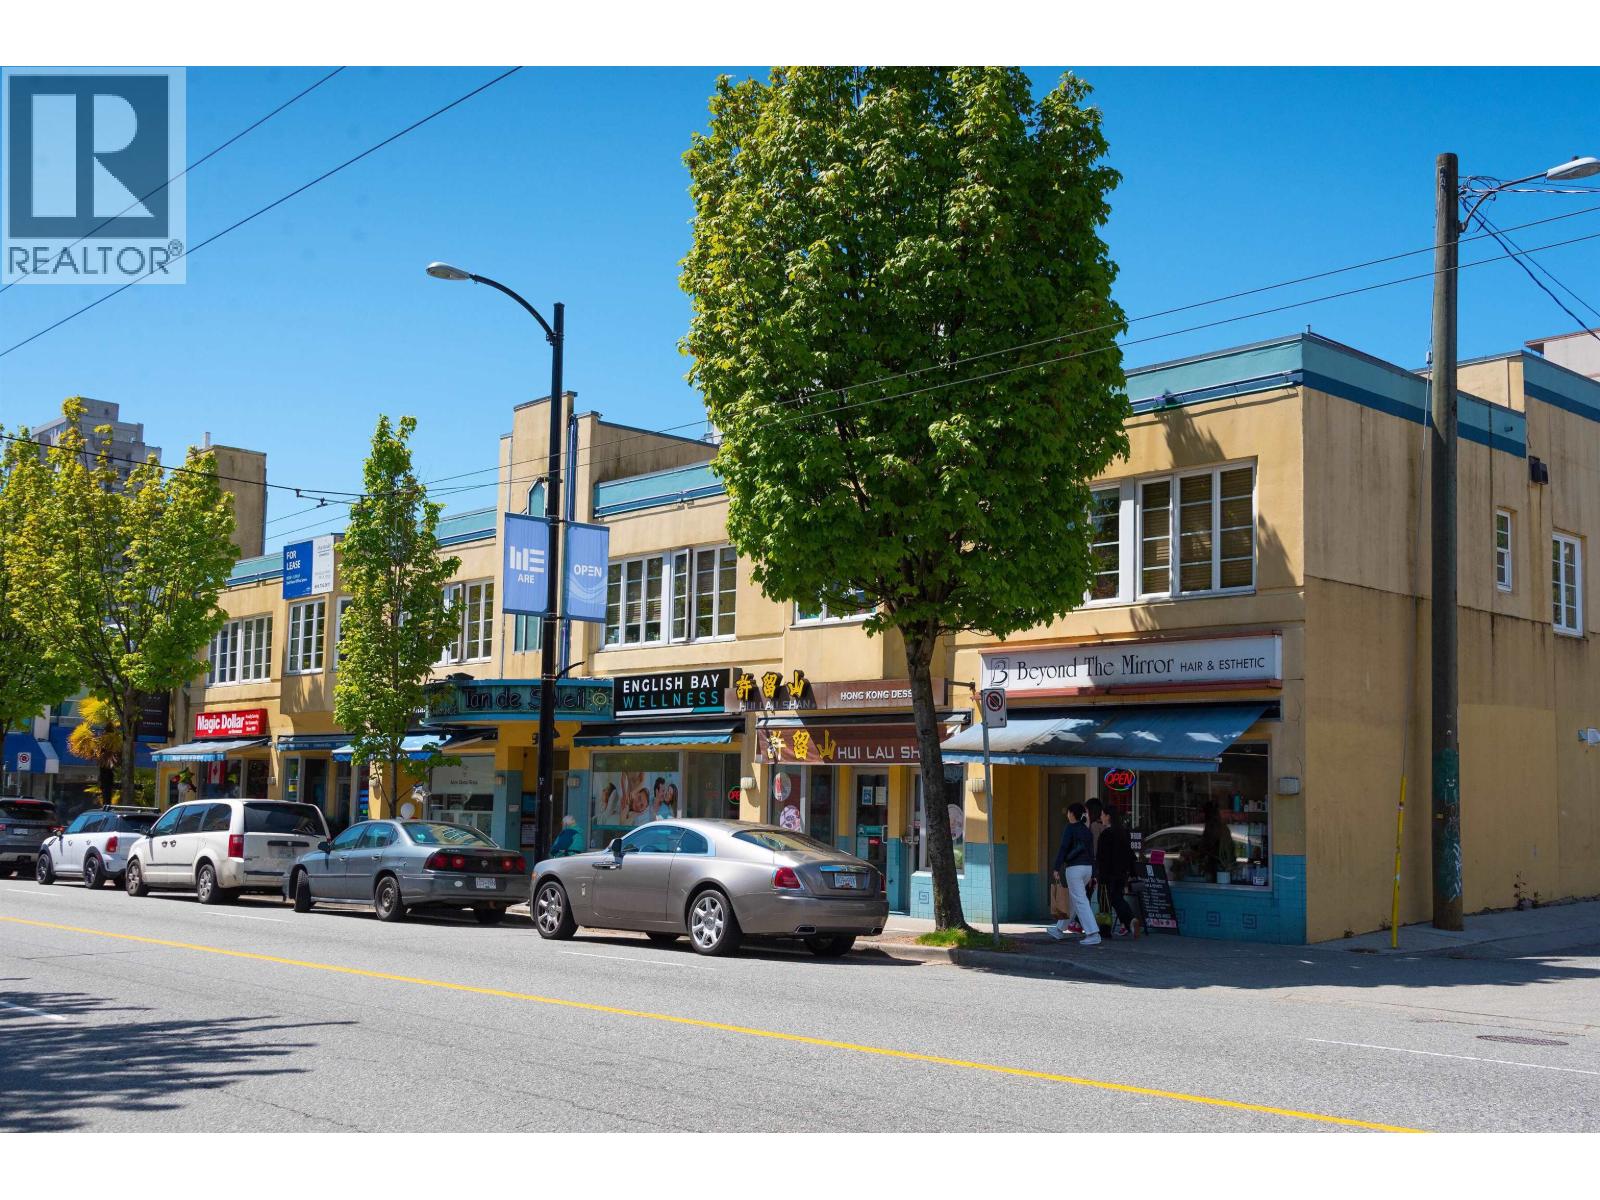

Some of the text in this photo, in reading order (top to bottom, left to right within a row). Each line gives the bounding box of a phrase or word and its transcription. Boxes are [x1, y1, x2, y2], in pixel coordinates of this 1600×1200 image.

[286, 550, 297, 560] FOR
[510, 546, 545, 573] WE
[286, 560, 301, 571] LEASE
[573, 564, 603, 577] OPEN
[517, 573, 536, 584] ARE
[1017, 654, 1265, 686] Beyond The Mirror HAIR & ESTHETIC
[623, 674, 720, 693] ENGLISH BAY
[462, 687, 586, 709] Tan de Sleil
[623, 691, 719, 709] WELLNESS
[840, 689, 912, 701] HONG KONG DESS
[197, 713, 245, 734] Magic Dollar
[837, 745, 921, 759] HUI LAU SH
[1106, 773, 1133, 785] OPEN
